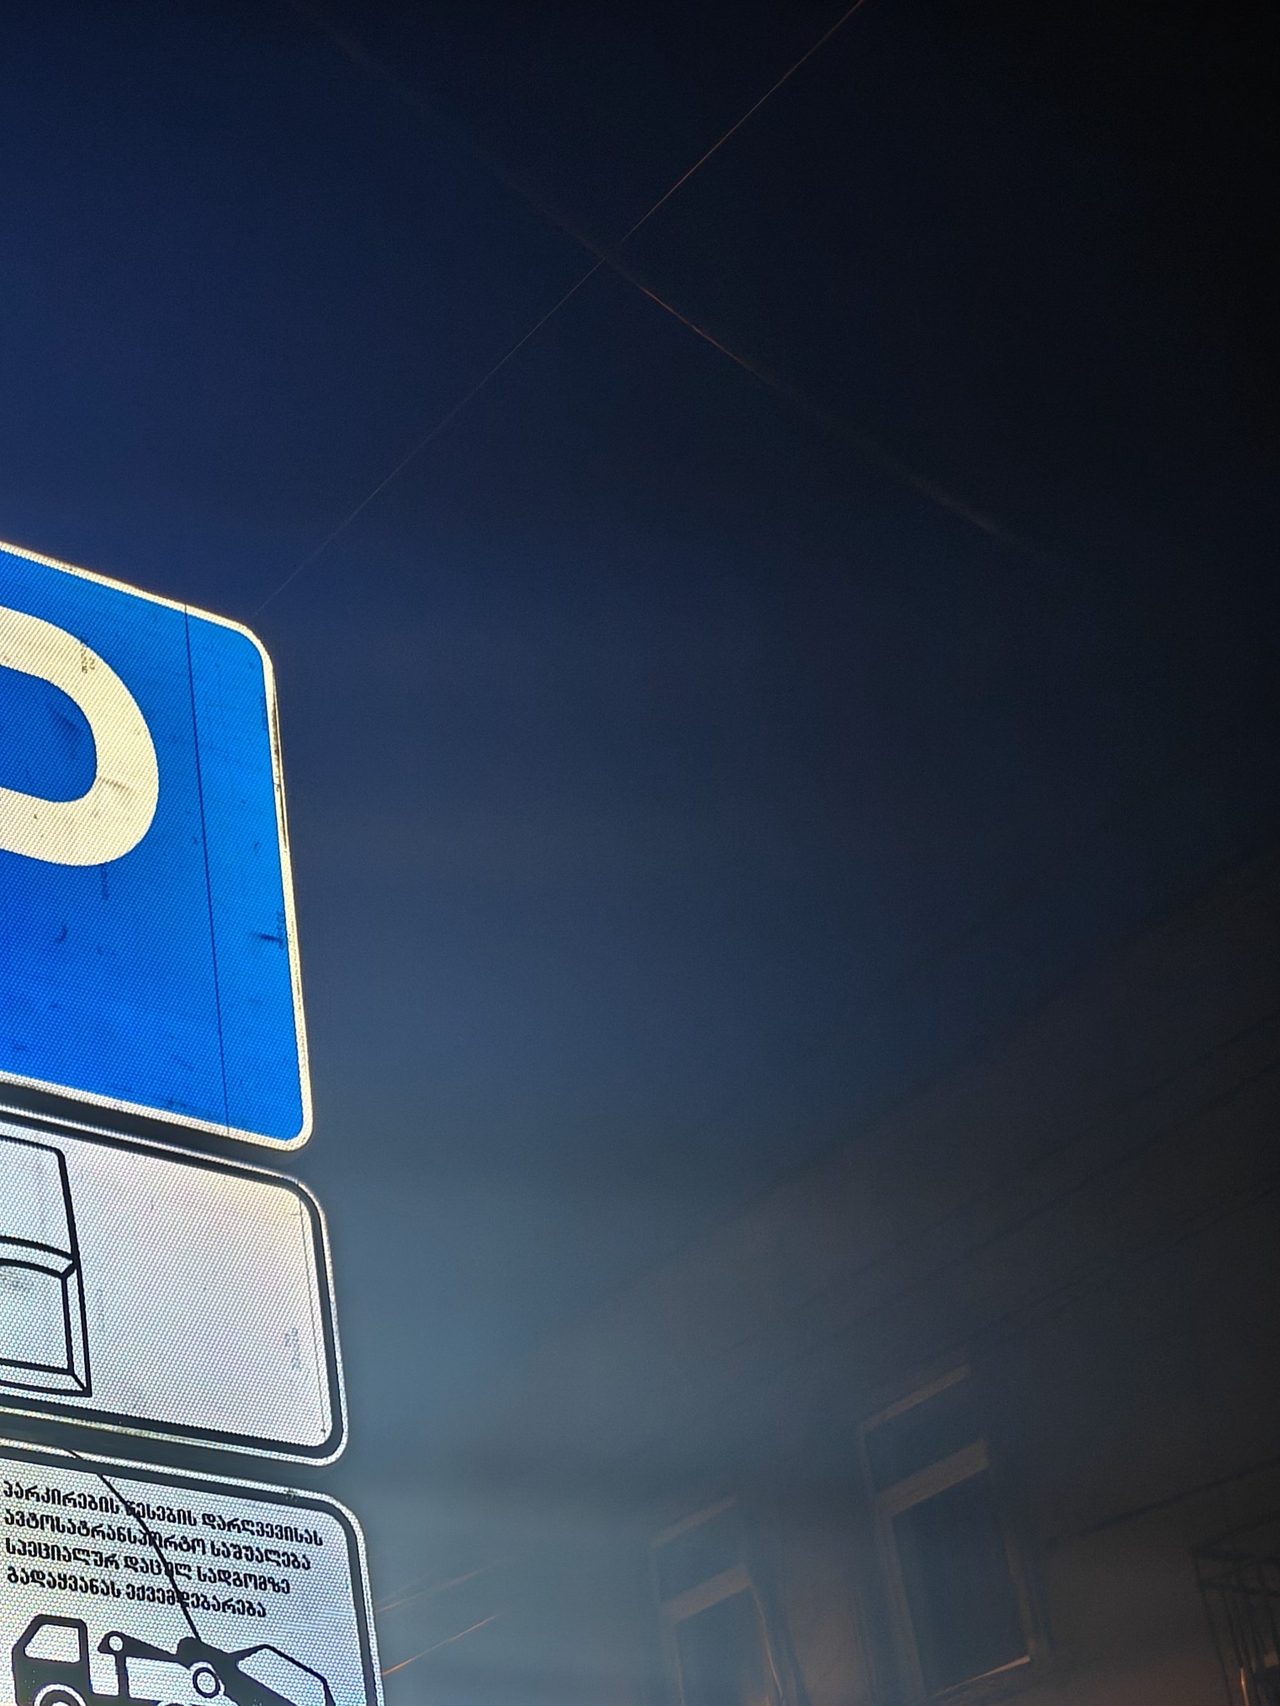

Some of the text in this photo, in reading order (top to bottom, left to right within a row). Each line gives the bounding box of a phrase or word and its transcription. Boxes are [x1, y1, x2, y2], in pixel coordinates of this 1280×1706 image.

[3, 1480, 120, 1514] პარკირების
[202, 1512, 324, 1546] დარღვევისას
[4, 1508, 312, 1570] ავტოსატრანსპორტო საშუალება
[5, 1537, 120, 1570] სპეციალურ
[196, 1565, 291, 1594] სადგომზე
[6, 1566, 267, 1617] გადაყვანას ექვემდებარება
